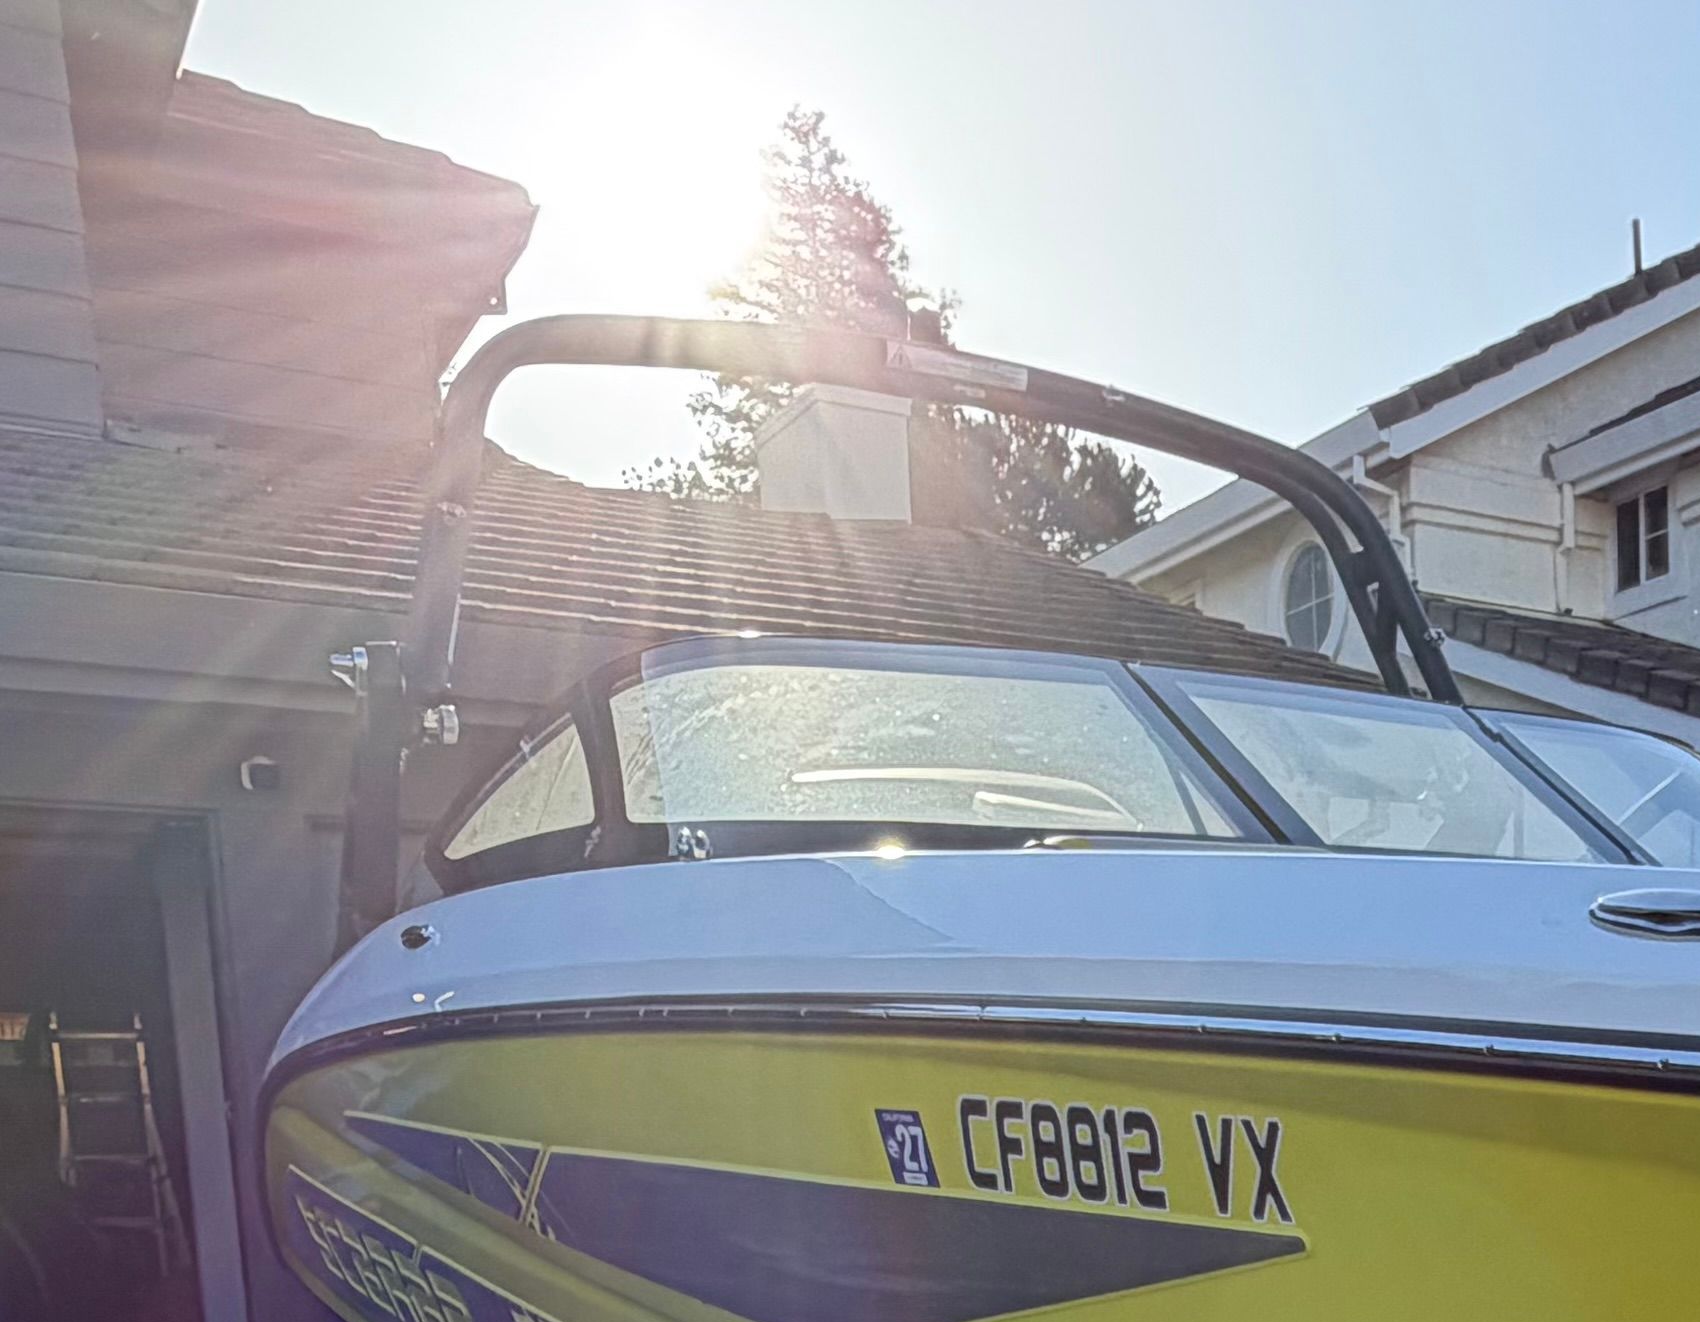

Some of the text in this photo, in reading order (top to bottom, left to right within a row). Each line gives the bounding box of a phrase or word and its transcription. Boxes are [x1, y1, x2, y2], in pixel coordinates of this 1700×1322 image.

[895, 1123, 928, 1172] 27
[958, 1094, 1295, 1224] CF8812 VX
